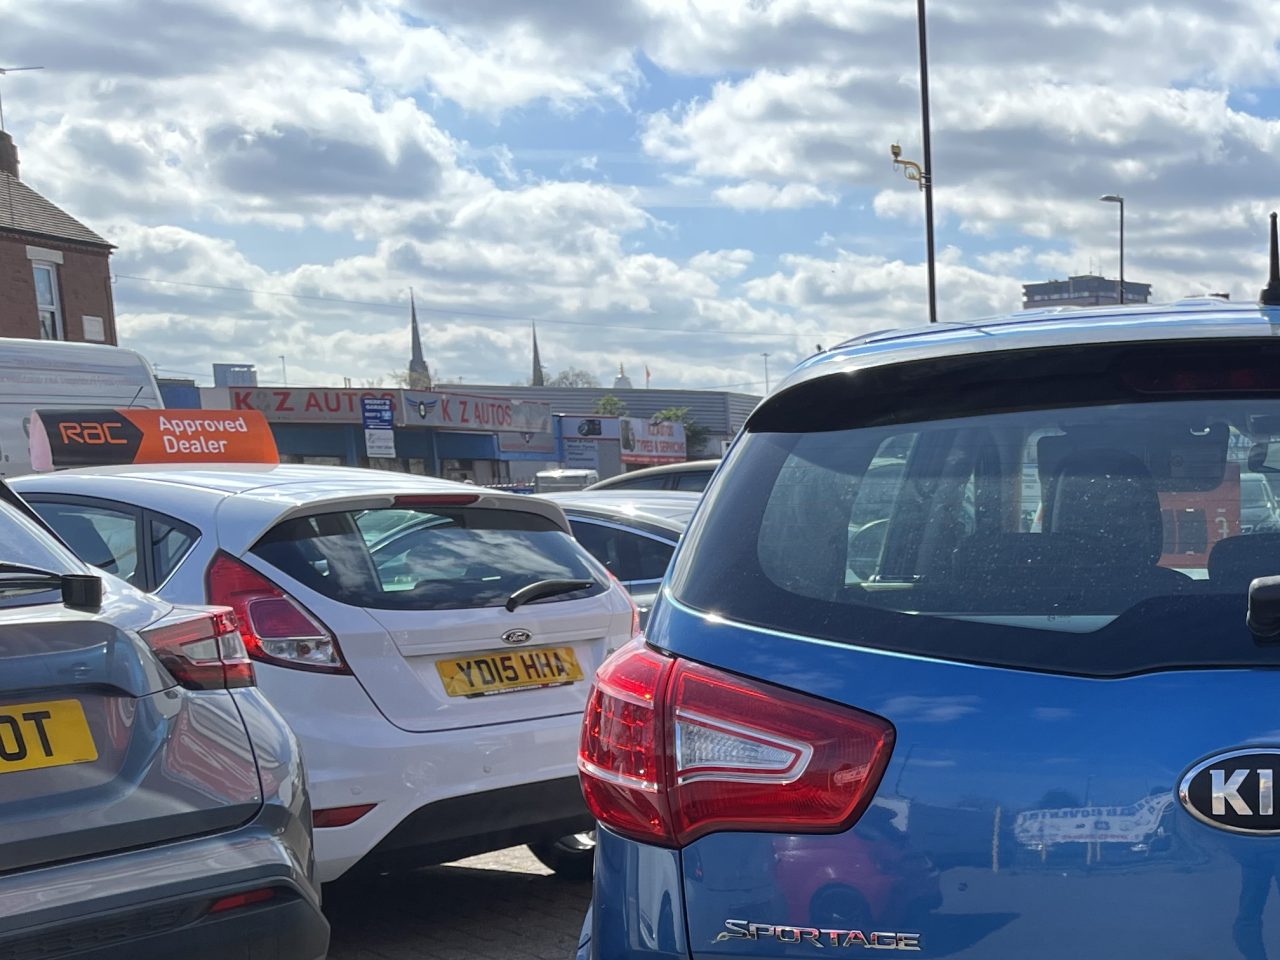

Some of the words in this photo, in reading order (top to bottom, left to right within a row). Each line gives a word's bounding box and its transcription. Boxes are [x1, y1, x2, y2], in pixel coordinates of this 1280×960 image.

[272, 391, 295, 412] Z
[441, 398, 453, 422] K
[459, 399, 470, 424] Z
[473, 401, 513, 426] AUTOS
[58, 422, 128, 445] RAC
[159, 415, 248, 437] Approved
[162, 436, 228, 454] Dealer
[456, 655, 520, 688] YD15
[519, 651, 570, 680] HHA
[711, 918, 921, 951] SPORTAGE
